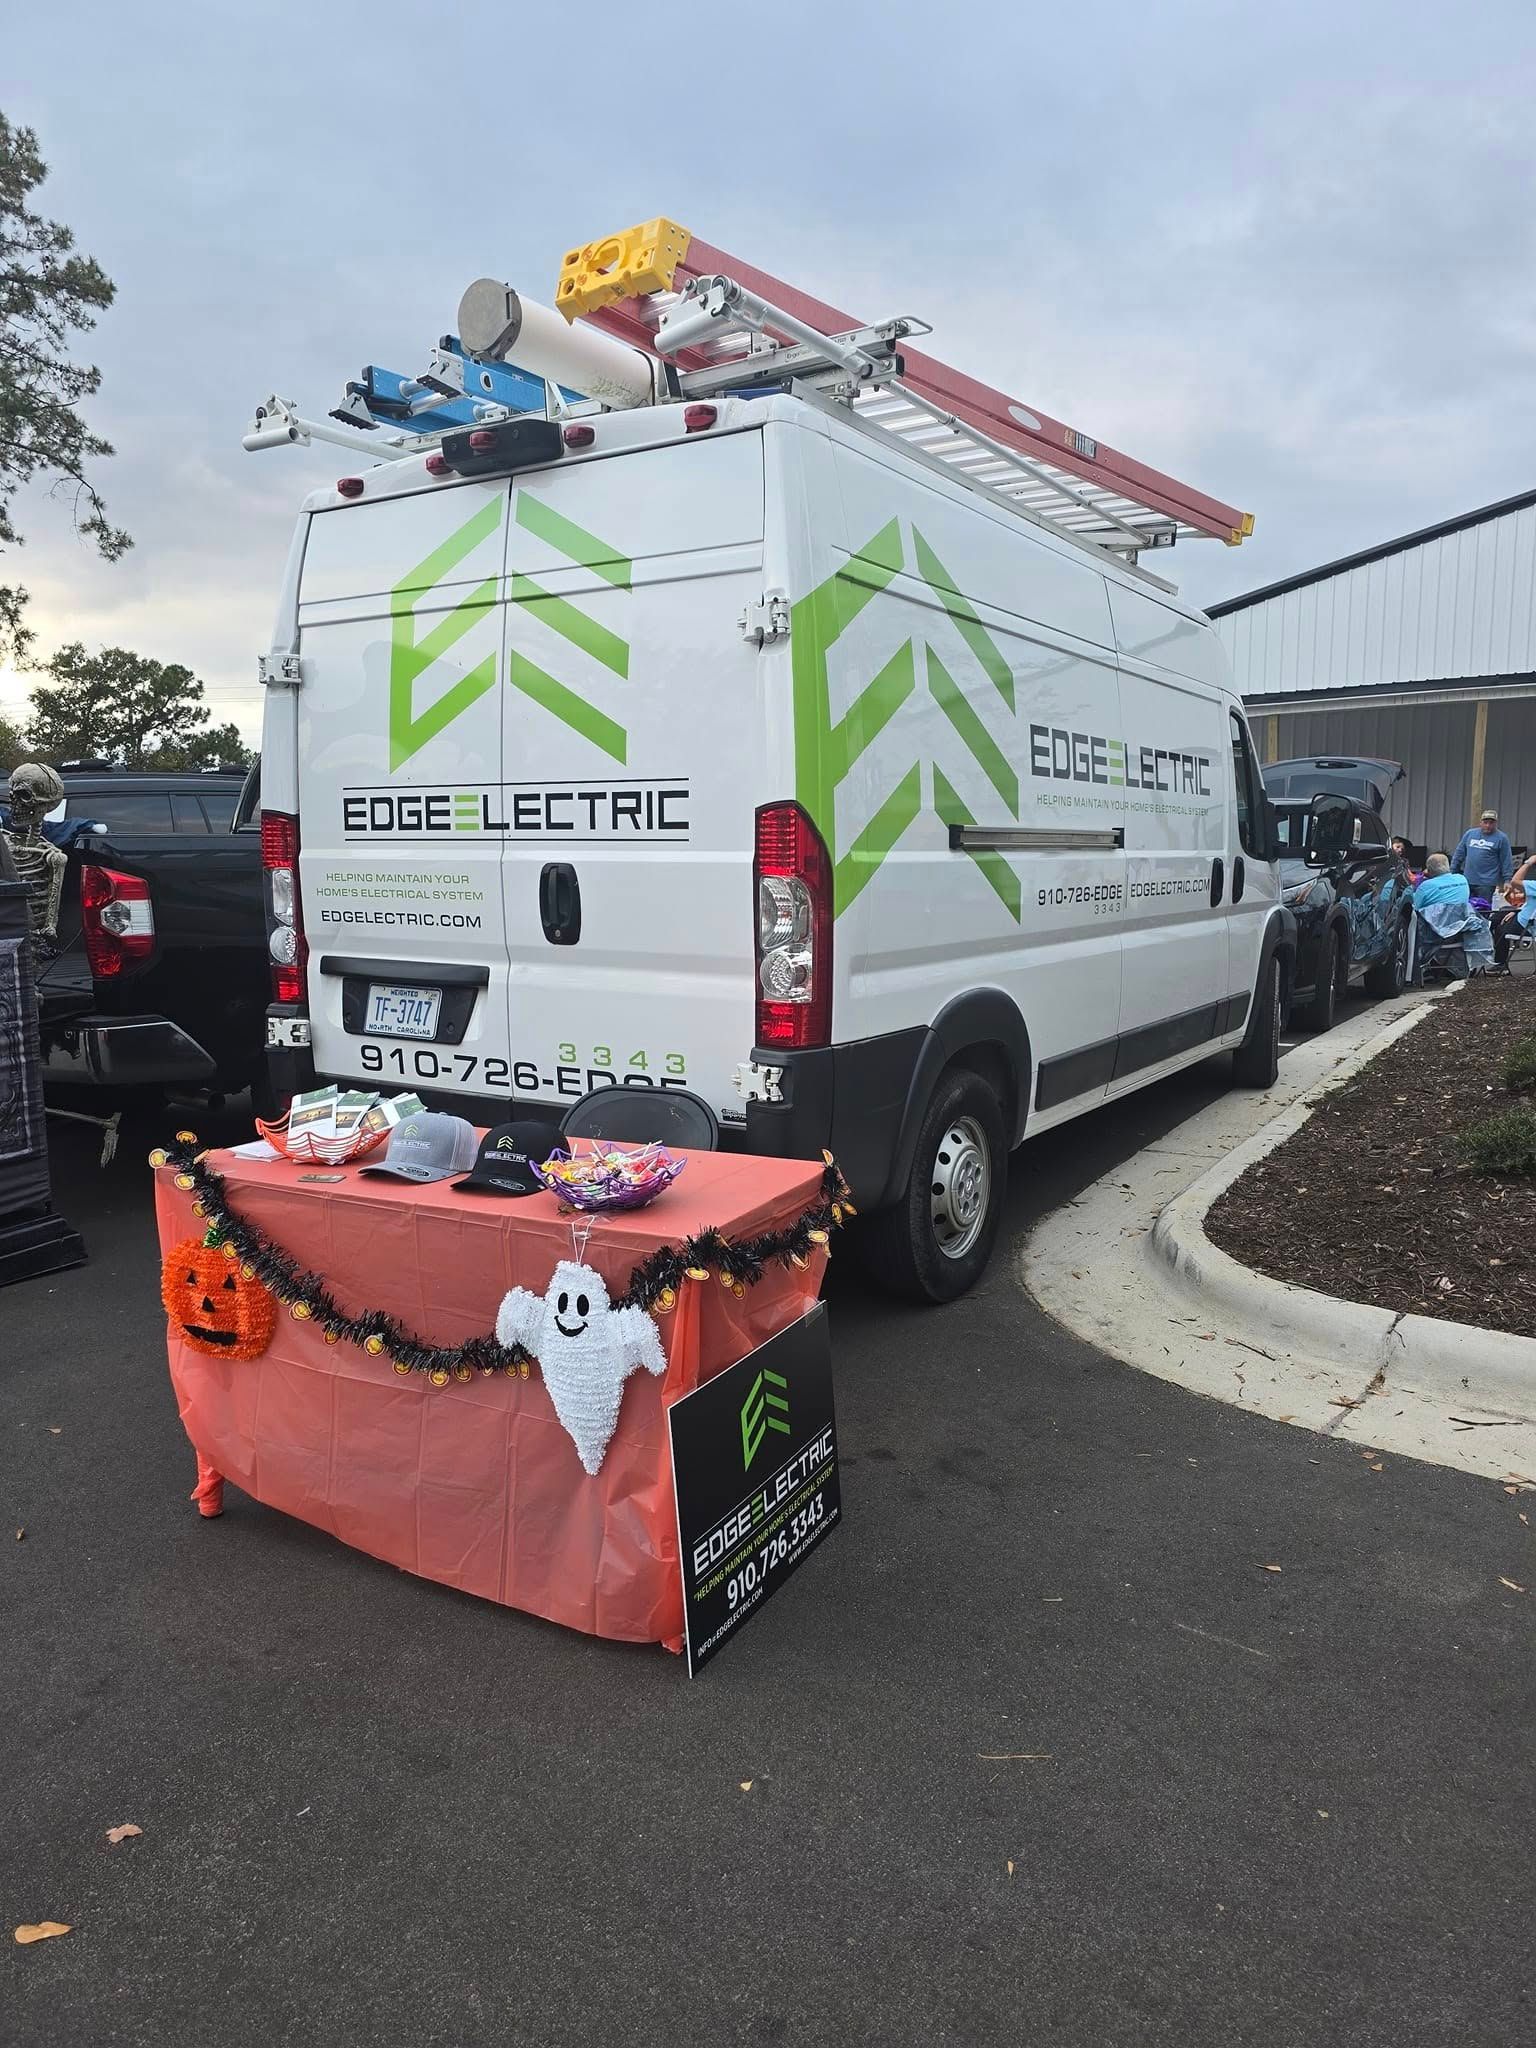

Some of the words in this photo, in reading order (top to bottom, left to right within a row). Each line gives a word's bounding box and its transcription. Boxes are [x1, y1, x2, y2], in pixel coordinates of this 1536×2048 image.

[1036, 794, 1072, 807] HELPING
[1074, 797, 1109, 809] MAINTAIN
[1110, 800, 1129, 811] YOUR
[1155, 804, 1188, 815] ELECTRICAL
[1188, 807, 1209, 817] SYSTEM
[326, 873, 373, 883] HELPING
[375, 874, 433, 884] MAINTAIN
[434, 875, 470, 884] YOUR
[316, 887, 359, 897] HOME'S
[361, 888, 430, 900] ELECTRICAL
[432, 891, 484, 901] SYSTEM
[1038, 884, 1123, 906] 910-726-EDGE
[1130, 879, 1211, 898] EDGELECTRIC.COM
[321, 910, 482, 929] EDGELECTRIC.COM
[390, 989, 419, 997] WEIGHTED
[375, 996, 433, 1027] TF-3747
[368, 1024, 392, 1032] NORTH
[396, 1026, 431, 1036] CAROLINA
[724, 1543, 753, 1576] MAINTAIN
[753, 1528, 769, 1549] YOUR
[769, 1510, 789, 1534] HOME'S
[788, 1482, 816, 1518] ELECTRICAL
[727, 1492, 824, 1610] 910.726.3343
